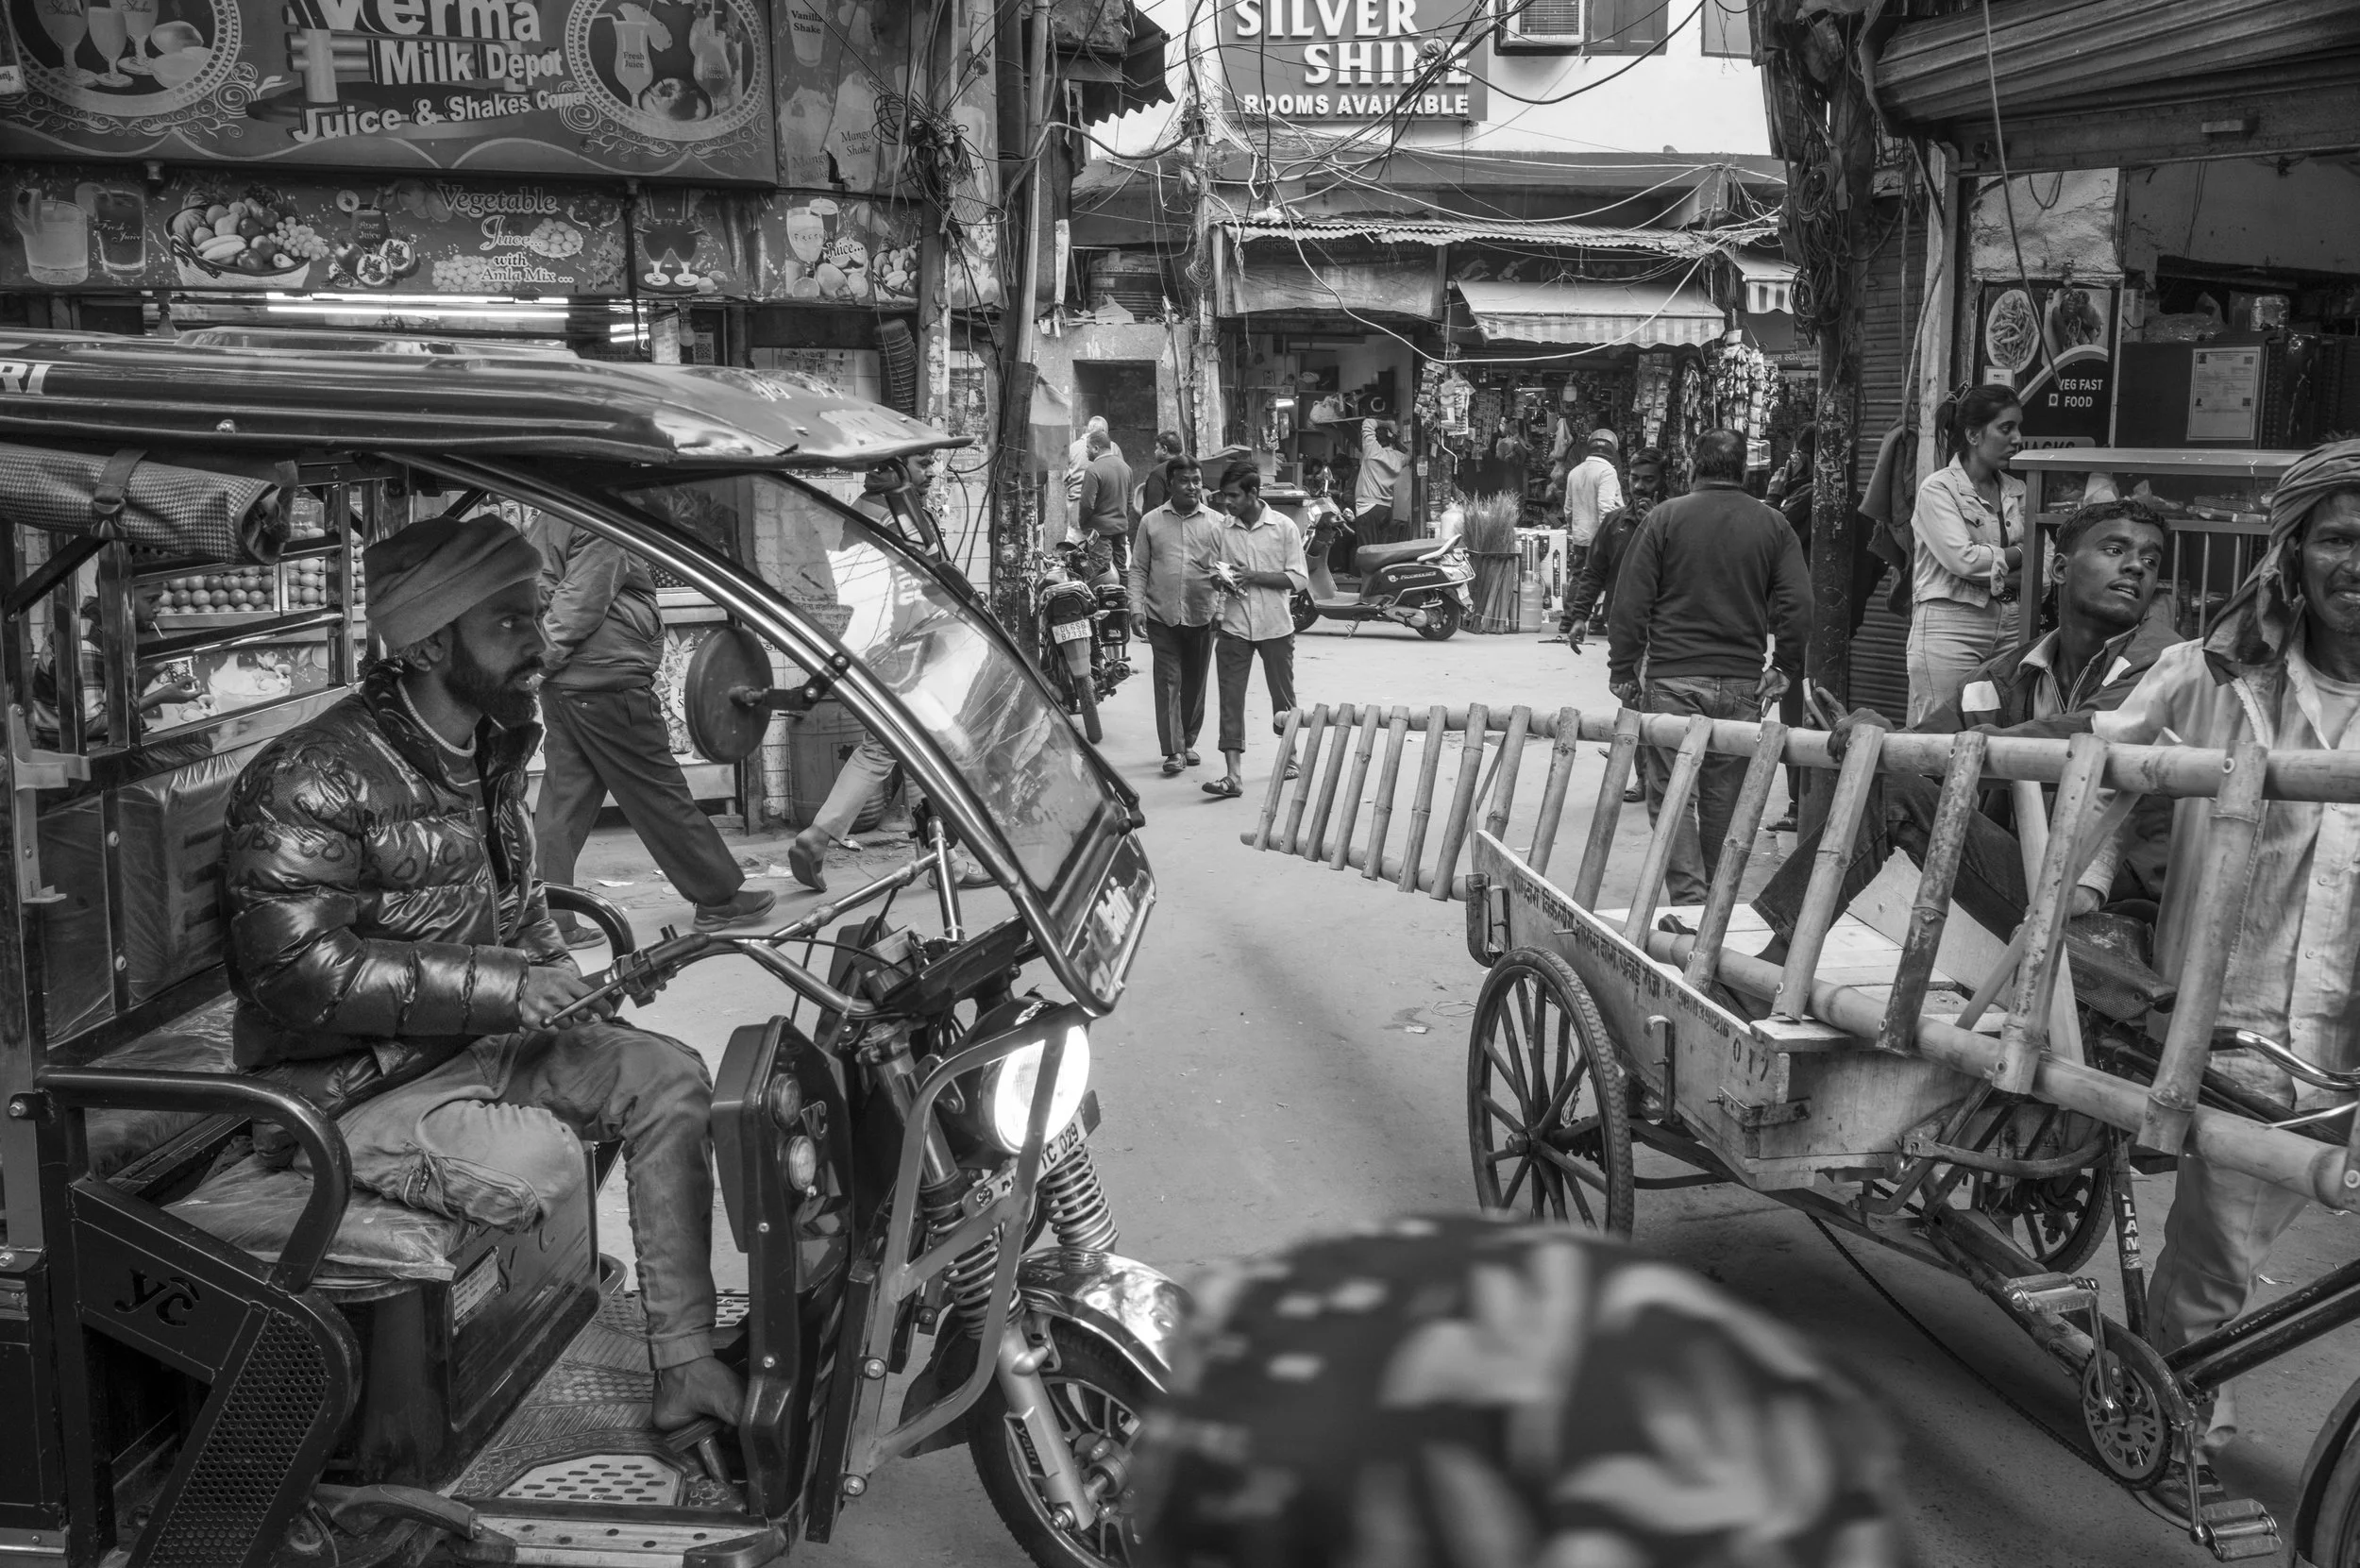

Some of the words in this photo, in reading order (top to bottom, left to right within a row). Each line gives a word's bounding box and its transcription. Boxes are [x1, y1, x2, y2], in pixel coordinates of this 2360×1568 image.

[791, 10, 823, 22] Vanilla
[1235, 0, 1422, 37] SILVER
[793, 22, 821, 35] Shake
[623, 51, 645, 60] Fresh
[379, 40, 474, 86] Milk
[483, 43, 565, 86] Depot
[624, 59, 645, 69] Juice
[1244, 94, 1329, 115] ROOMS
[293, 106, 402, 143] Juice
[415, 98, 438, 126] &
[448, 93, 530, 122] Shakes
[536, 89, 587, 110] Corner
[841, 130, 872, 143] Mango
[846, 143, 872, 158] Shake
[437, 185, 560, 218] Vegetable
[494, 254, 528, 268] with
[480, 267, 521, 282] Amla
[524, 267, 556, 282] Mix
[2060, 379, 2077, 391] VEG
[2080, 379, 2104, 391] FAST
[2065, 396, 2093, 408] FOOD
